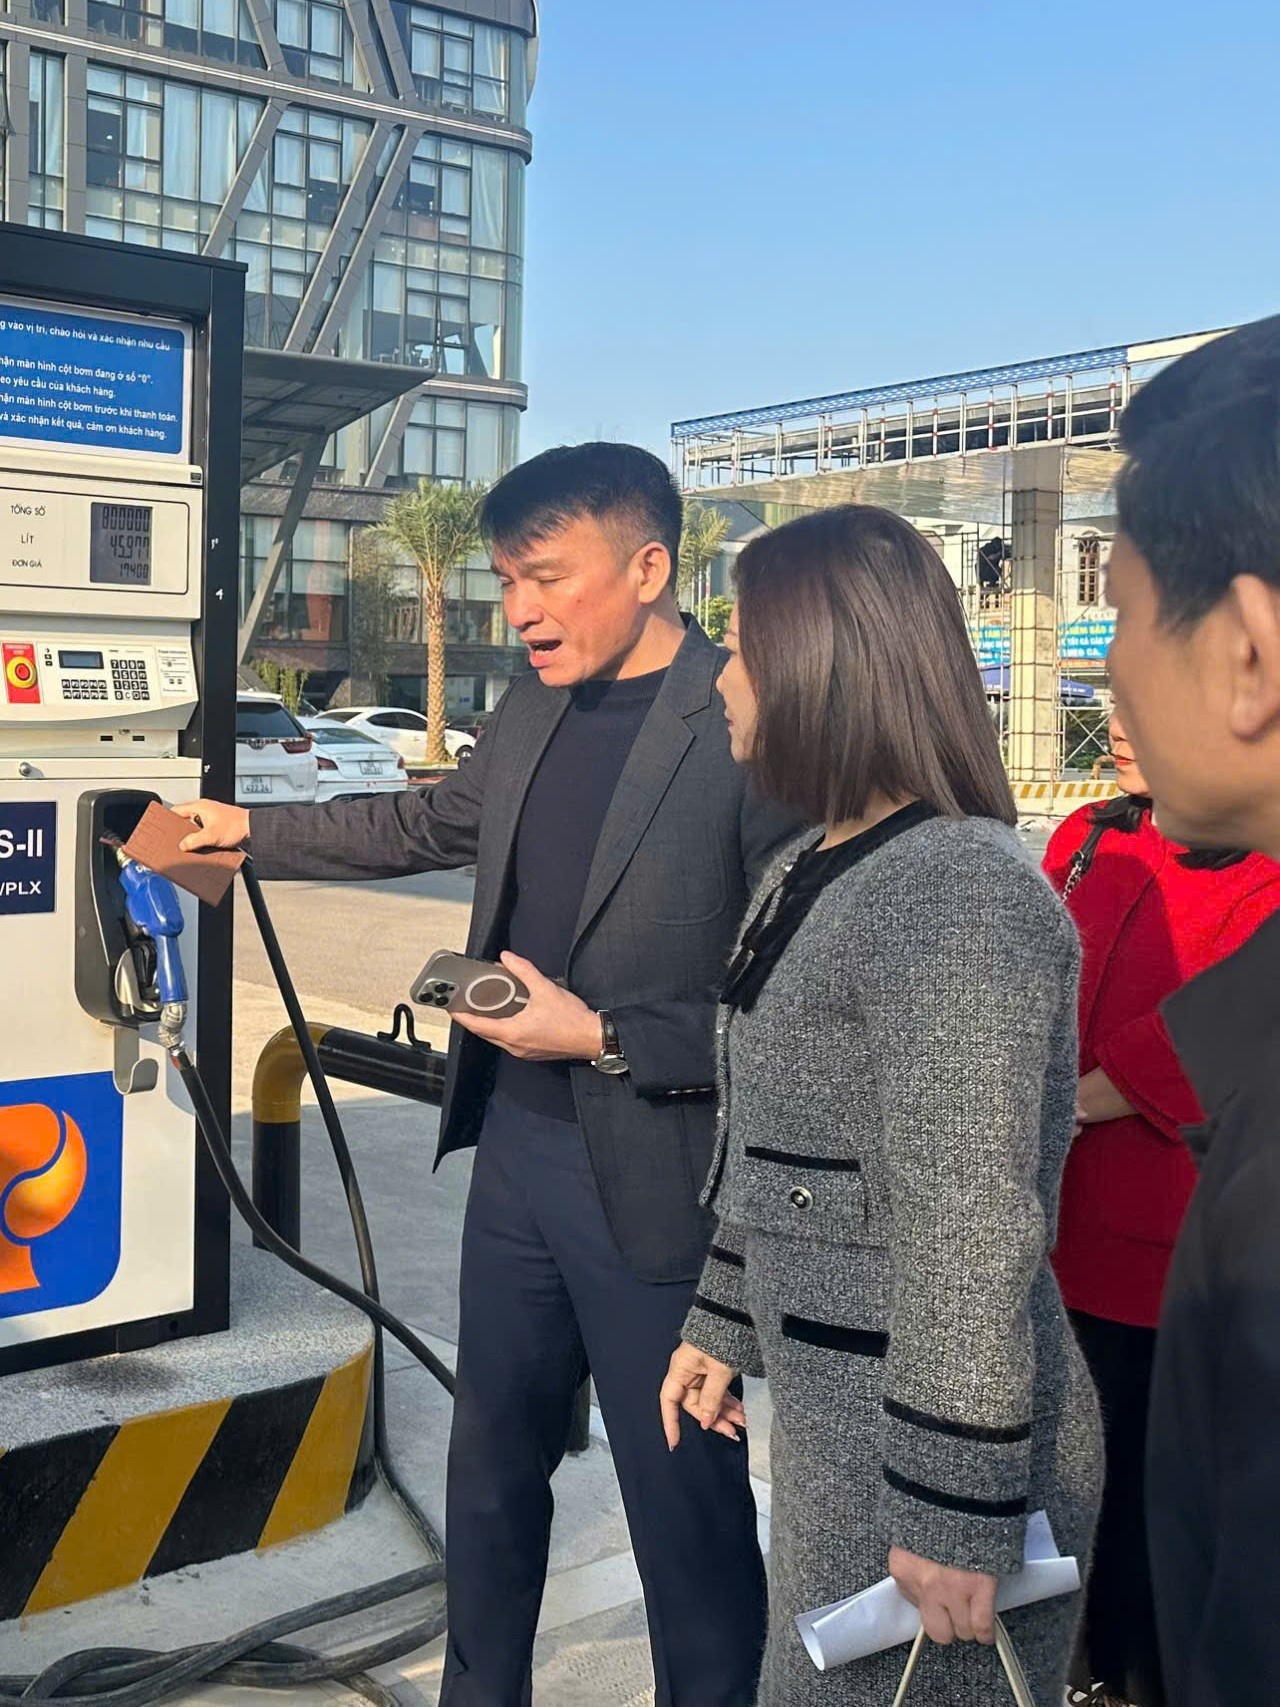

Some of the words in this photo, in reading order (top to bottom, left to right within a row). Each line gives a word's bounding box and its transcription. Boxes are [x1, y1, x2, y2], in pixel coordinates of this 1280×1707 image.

[16, 358, 36, 369] màn
[37, 360, 57, 372] hình
[58, 363, 72, 375] cột
[73, 365, 94, 376] bơm
[95, 368, 116, 381] đang
[117, 370, 125, 380] ở
[125, 370, 136, 382] số
[13, 376, 29, 387] yêu
[31, 376, 47, 389] cầu
[48, 380, 64, 391] của
[65, 382, 91, 394] khách
[93, 386, 116, 399] hàng.
[16, 395, 36, 406] màn
[37, 397, 57, 408] hình
[58, 400, 72, 412] cột
[73, 401, 93, 412] bơm
[94, 404, 118, 415] trước
[120, 406, 132, 417] khi
[134, 408, 157, 420] thanh
[158, 411, 178, 422] toán.
[10, 413, 26, 423] xác
[28, 415, 49, 427] nhận
[51, 416, 64, 427] kết
[66, 419, 84, 430] quả,
[105, 424, 117, 433] ơn
[118, 425, 143, 436] khách
[144, 428, 167, 440] hàng.
[102, 506, 150, 532] 800000
[21, 532, 34, 544] LÍT
[120, 562, 149, 579] 17400
